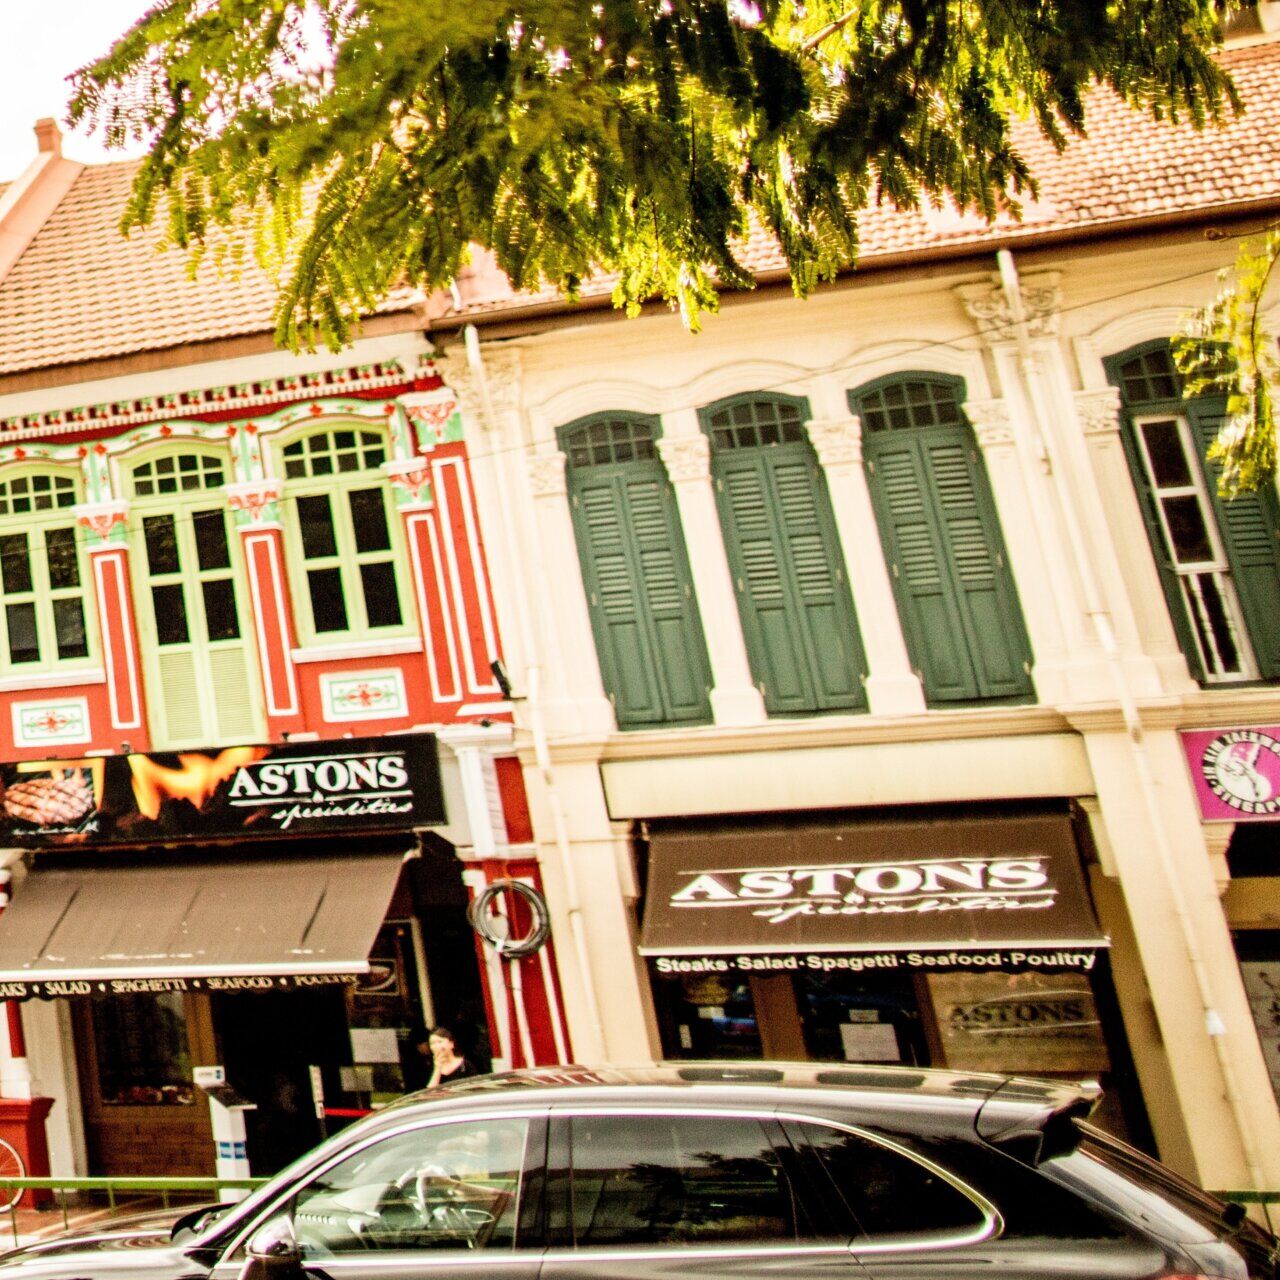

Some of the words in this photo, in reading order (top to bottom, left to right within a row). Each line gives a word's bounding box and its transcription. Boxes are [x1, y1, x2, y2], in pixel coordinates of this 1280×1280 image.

[228, 756, 409, 797] ASTONS
[670, 860, 1048, 901] ASTONS
[656, 957, 729, 972] Steaks
[737, 956, 798, 970] Salad
[806, 954, 898, 972] Spagetti
[907, 952, 1002, 967] Seafood
[1010, 951, 1096, 969] Poultry
[44, 980, 91, 995] SALAD
[111, 977, 188, 994] SPAGHETTI
[207, 976, 273, 990] SEAFOOD
[951, 999, 1084, 1021] ASTONS
